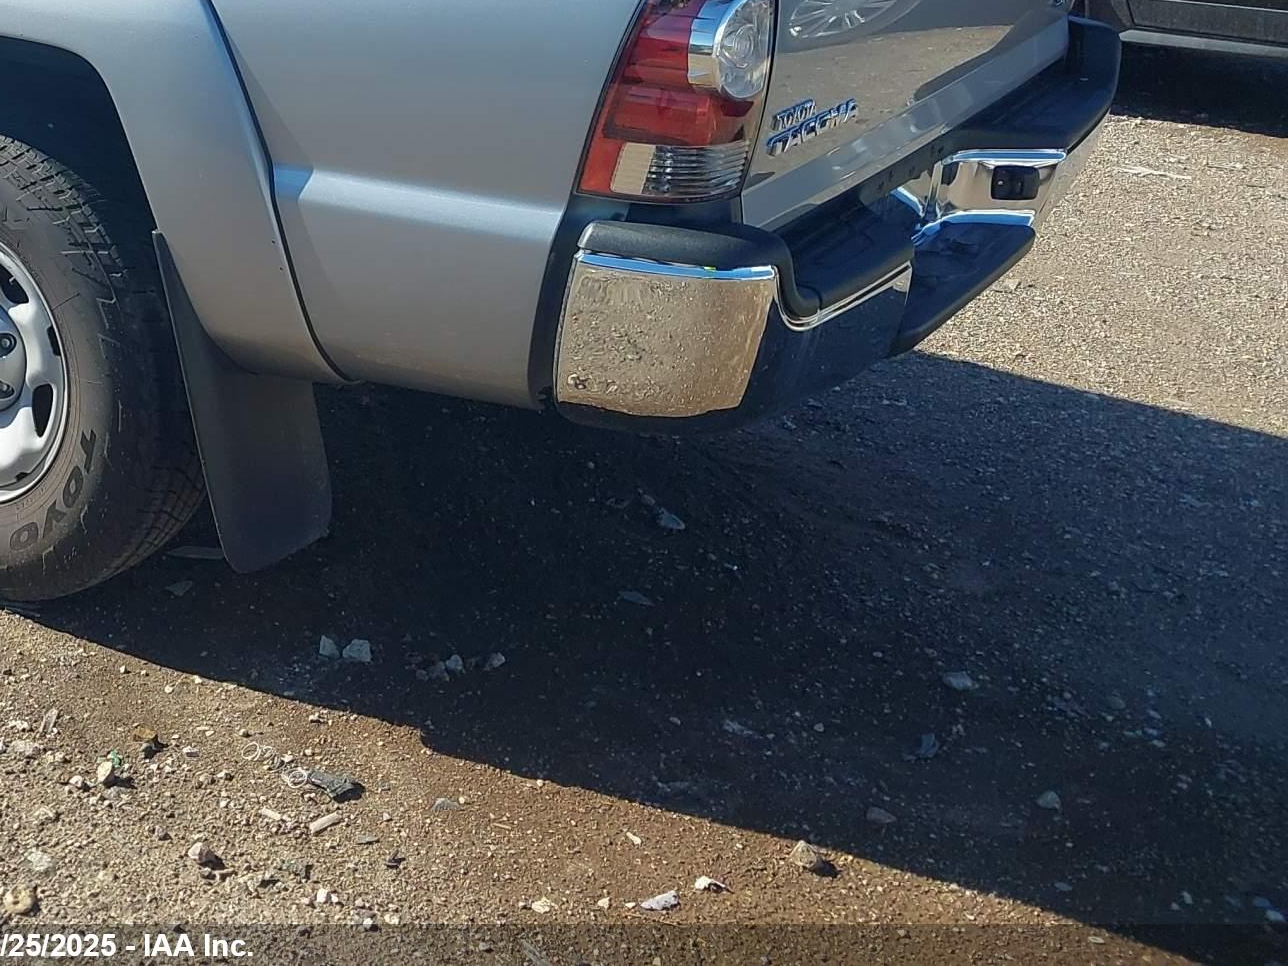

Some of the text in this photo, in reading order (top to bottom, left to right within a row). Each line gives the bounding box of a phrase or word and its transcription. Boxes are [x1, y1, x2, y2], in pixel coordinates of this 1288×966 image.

[766, 97, 858, 157] TACOMA
[772, 98, 817, 131] TOYOTA
[9, 429, 98, 552] TOYO
